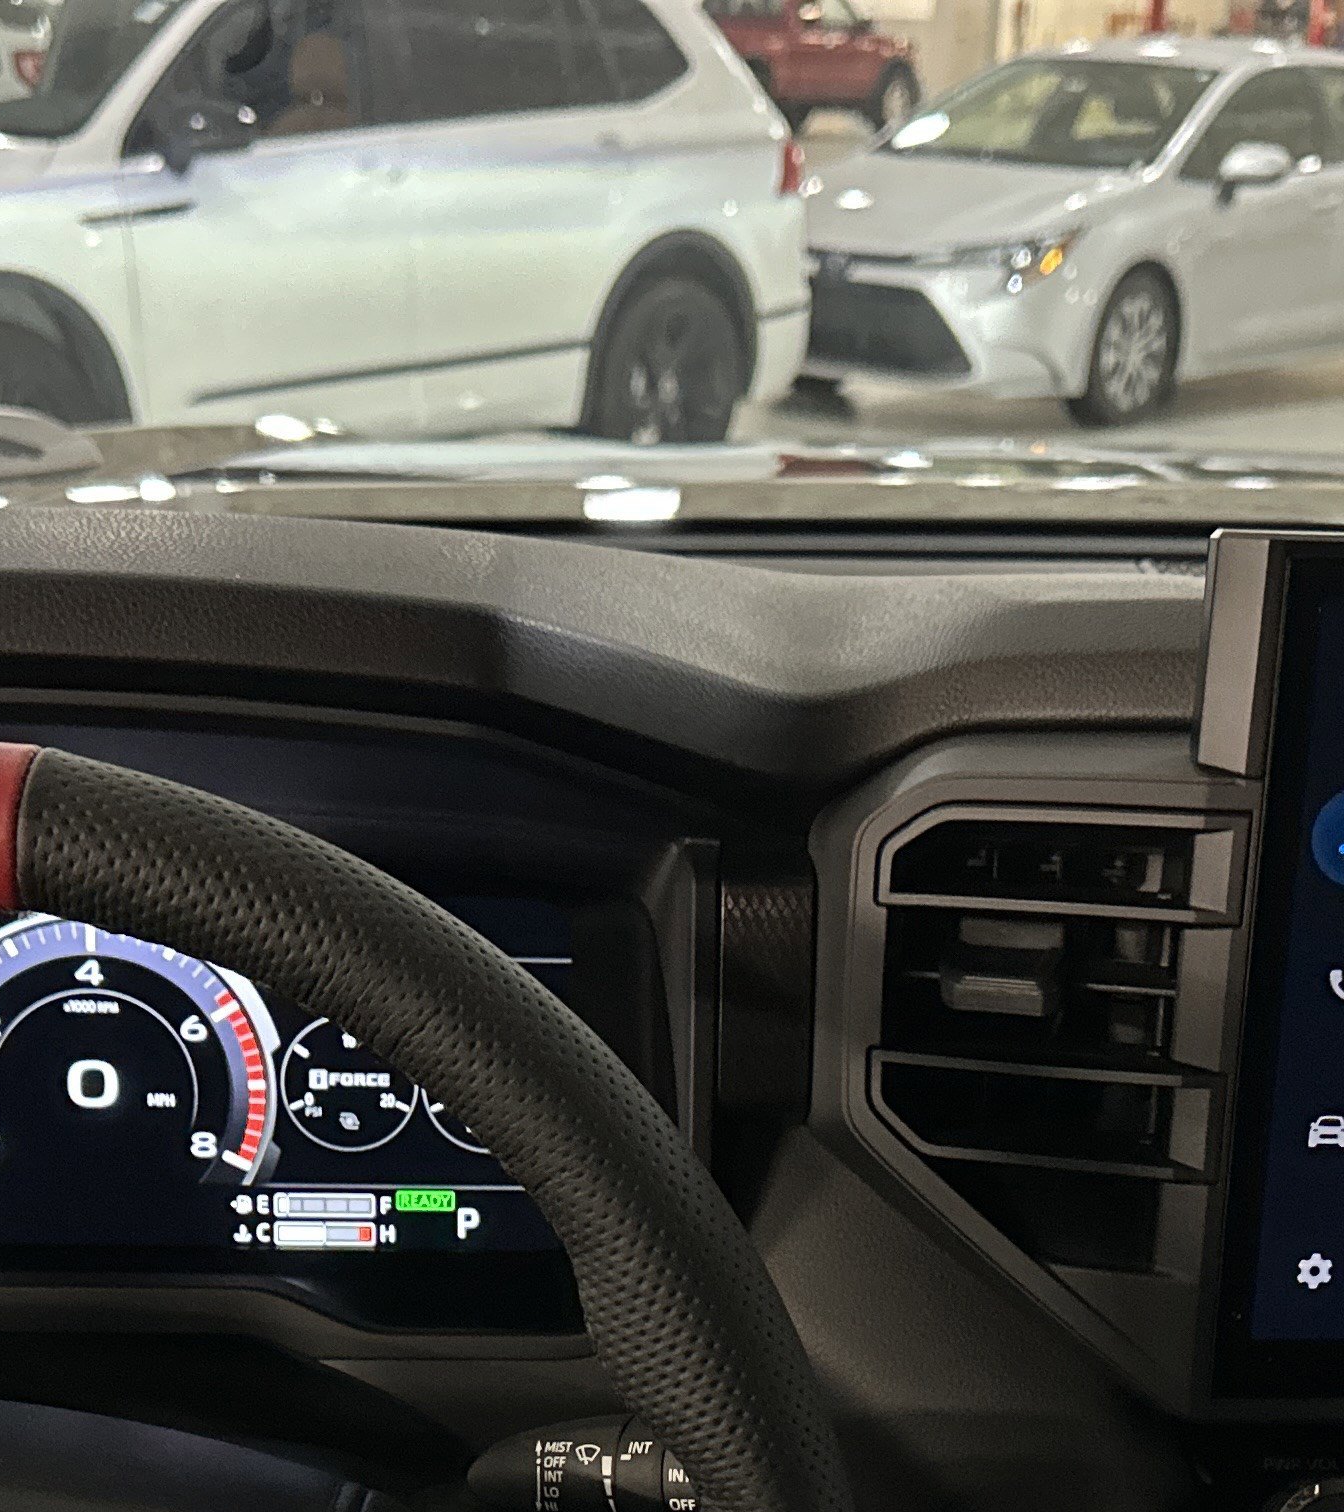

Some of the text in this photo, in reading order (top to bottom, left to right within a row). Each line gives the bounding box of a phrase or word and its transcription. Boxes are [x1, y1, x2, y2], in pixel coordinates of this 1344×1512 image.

[74, 959, 104, 986] 4
[179, 1014, 208, 1042] 6
[66, 1059, 120, 1109] 0
[146, 1092, 176, 1108] MPH
[189, 1131, 218, 1158] 8
[398, 1192, 453, 1210] READY
[456, 1207, 480, 1240] P
[544, 1441, 573, 1453] MIST
[627, 1441, 653, 1454] INT
[543, 1456, 567, 1469] OFF
[544, 1470, 563, 1483] INT
[543, 1486, 560, 1499] LO
[669, 1498, 696, 1511] OFF
